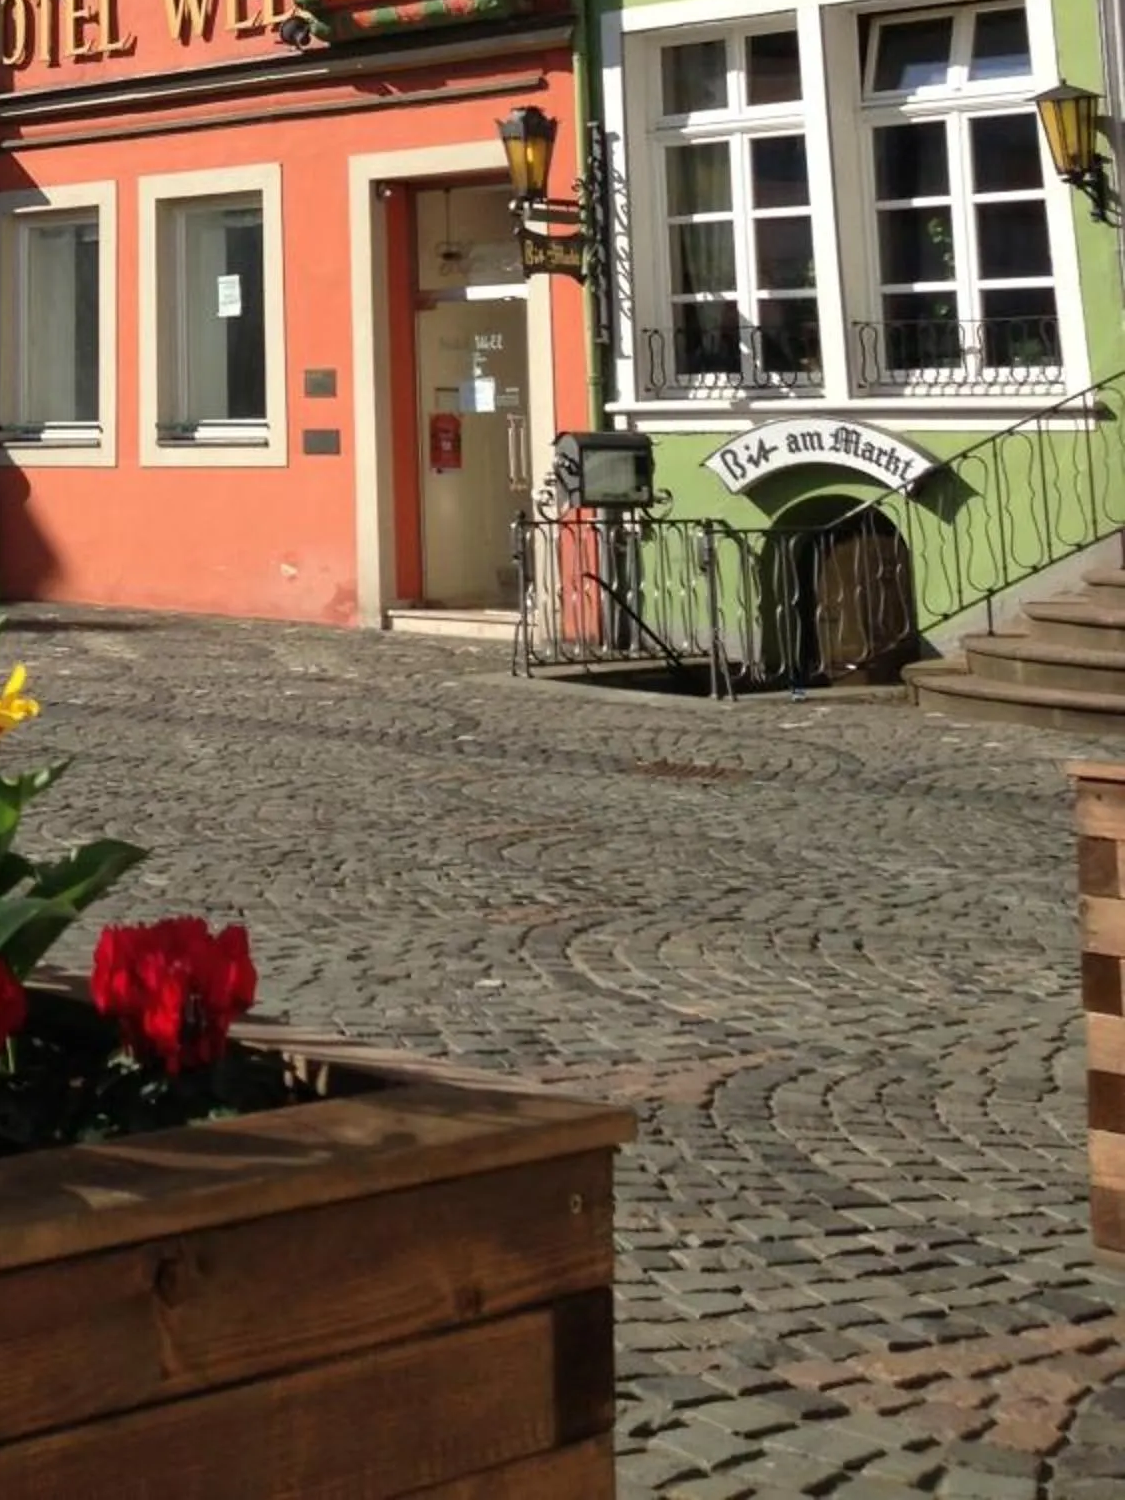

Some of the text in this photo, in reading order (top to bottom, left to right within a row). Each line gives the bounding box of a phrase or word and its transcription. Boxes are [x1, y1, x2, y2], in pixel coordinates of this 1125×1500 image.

[719, 426, 916, 482] Bit am Markt
